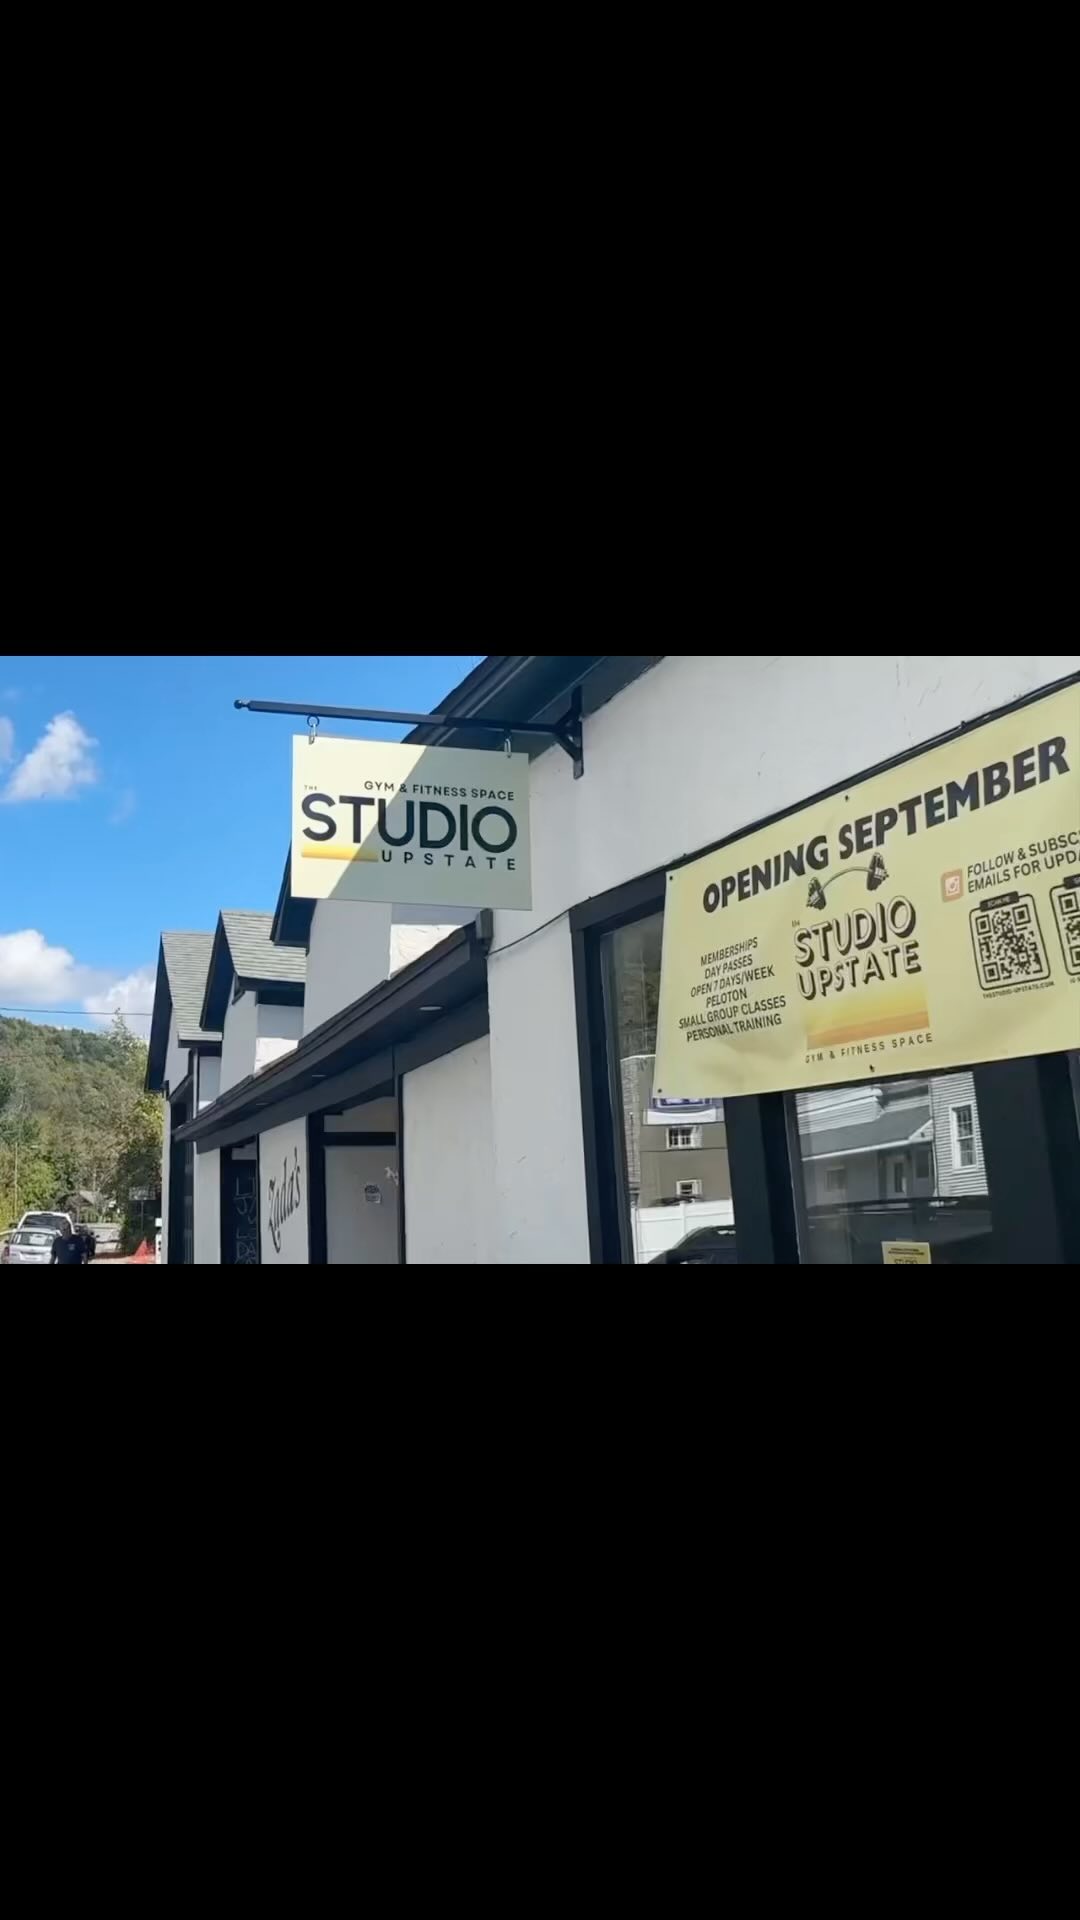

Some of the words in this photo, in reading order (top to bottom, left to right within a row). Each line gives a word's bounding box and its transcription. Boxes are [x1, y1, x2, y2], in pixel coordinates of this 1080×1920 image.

[364, 781, 395, 792] GYM
[399, 784, 407, 793] &
[412, 785, 467, 797] FITNESS
[471, 789, 514, 801] SPACE
[301, 794, 518, 853] STUDIO
[702, 835, 828, 913] OPENING
[839, 735, 1070, 860] SEPTEMBER
[382, 850, 516, 870] UPSTATE
[967, 850, 1015, 878] FOLLOW
[1018, 848, 1026, 861] &
[1028, 830, 1080, 857] SUBSC
[968, 869, 1010, 894] EMAILS
[1014, 860, 1042, 880] FOR
[1044, 849, 1080, 870] UPD
[794, 895, 916, 967] STUDIO
[700, 936, 758, 966] MEMBERSHIPS
[704, 963, 722, 980] DAY
[722, 954, 753, 975] PASSES
[690, 982, 712, 998] OPEN
[719, 964, 775, 990] DAYS/WEEK
[796, 940, 922, 1000] UPSTATE
[678, 1011, 706, 1030] SMALL
[706, 1004, 740, 1024] GROUP
[740, 995, 786, 1017] CLASSES
[706, 988, 748, 1008] PELOTON
[686, 1022, 734, 1042] PERSONAL
[734, 1012, 782, 1034] TRAINING
[806, 1052, 824, 1064] GYM
[829, 1050, 836, 1060] &
[840, 1040, 886, 1057] FITNESS
[891, 1032, 934, 1050] SPACE
